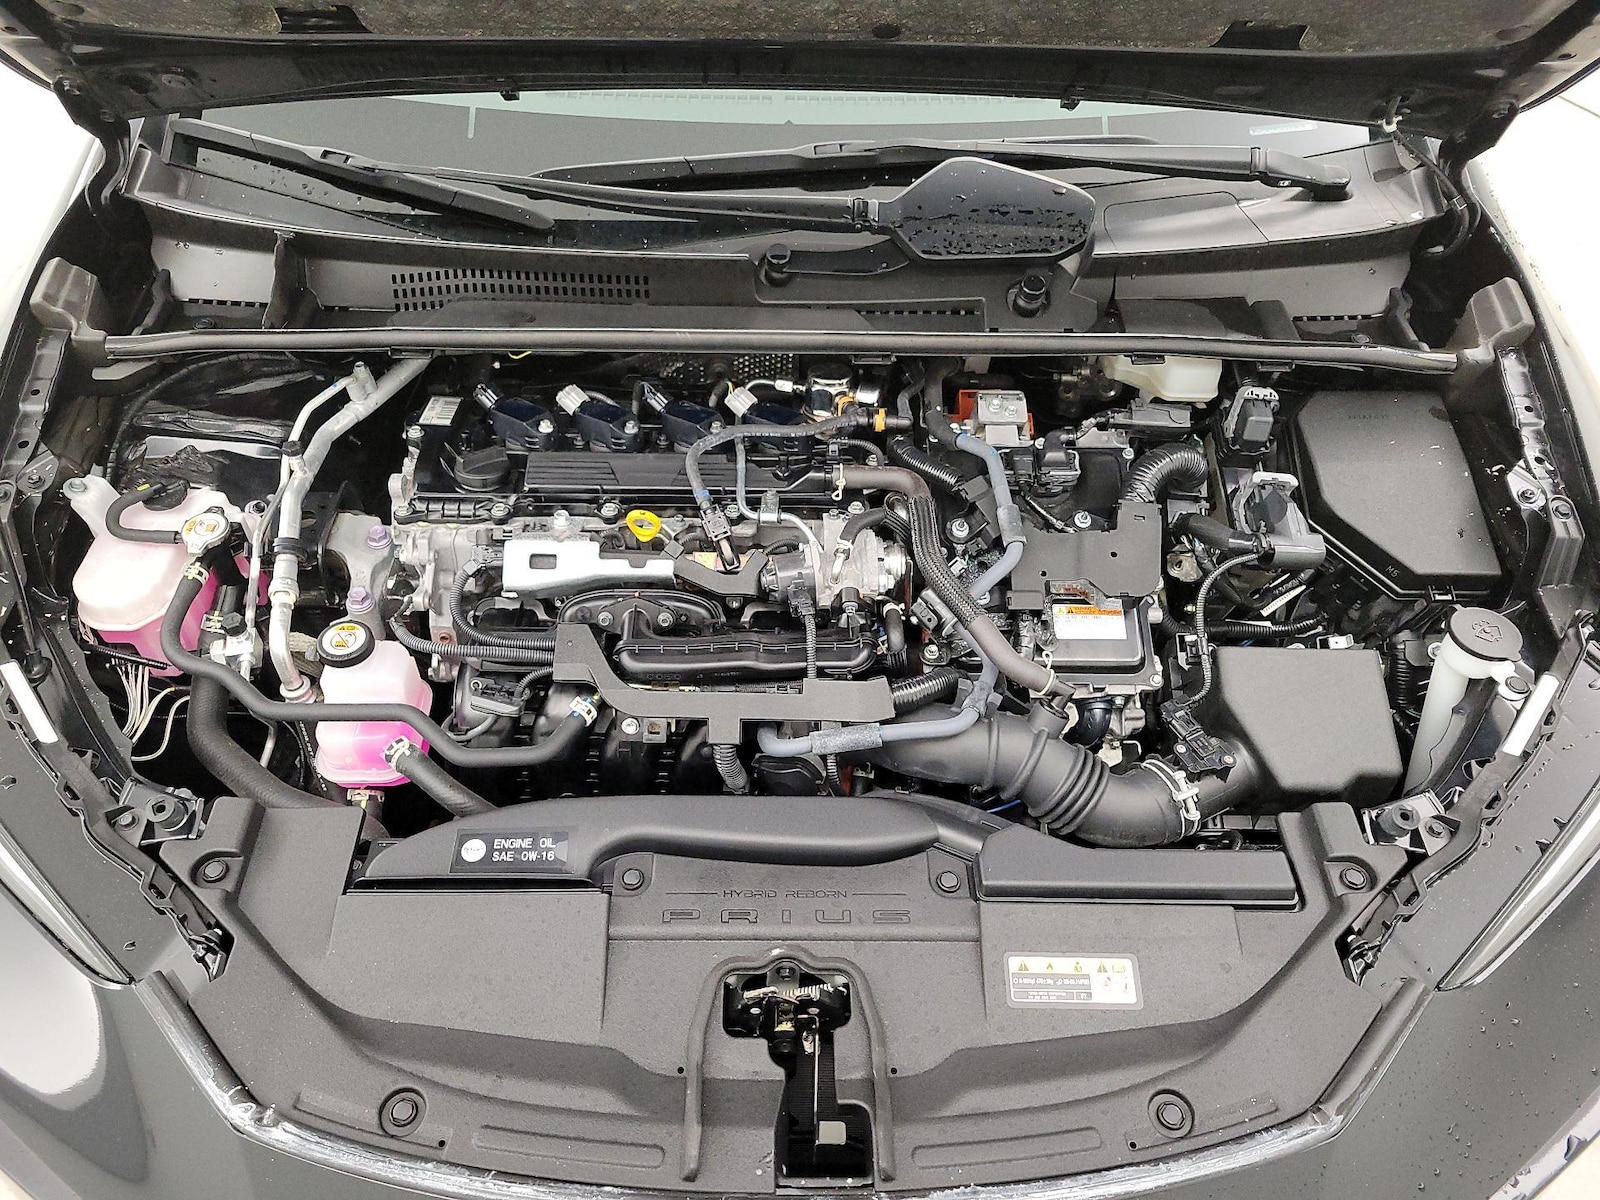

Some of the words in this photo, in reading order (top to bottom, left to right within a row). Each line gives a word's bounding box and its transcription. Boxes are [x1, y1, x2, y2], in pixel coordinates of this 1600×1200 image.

[493, 838, 534, 849] ENGINE
[539, 837, 556, 848] OIL
[491, 851, 515, 861] SAE
[521, 851, 555, 861] 0W-16
[723, 889, 777, 898] HYBRID
[785, 890, 847, 899] REBORN
[662, 908, 911, 924] PRIUS
